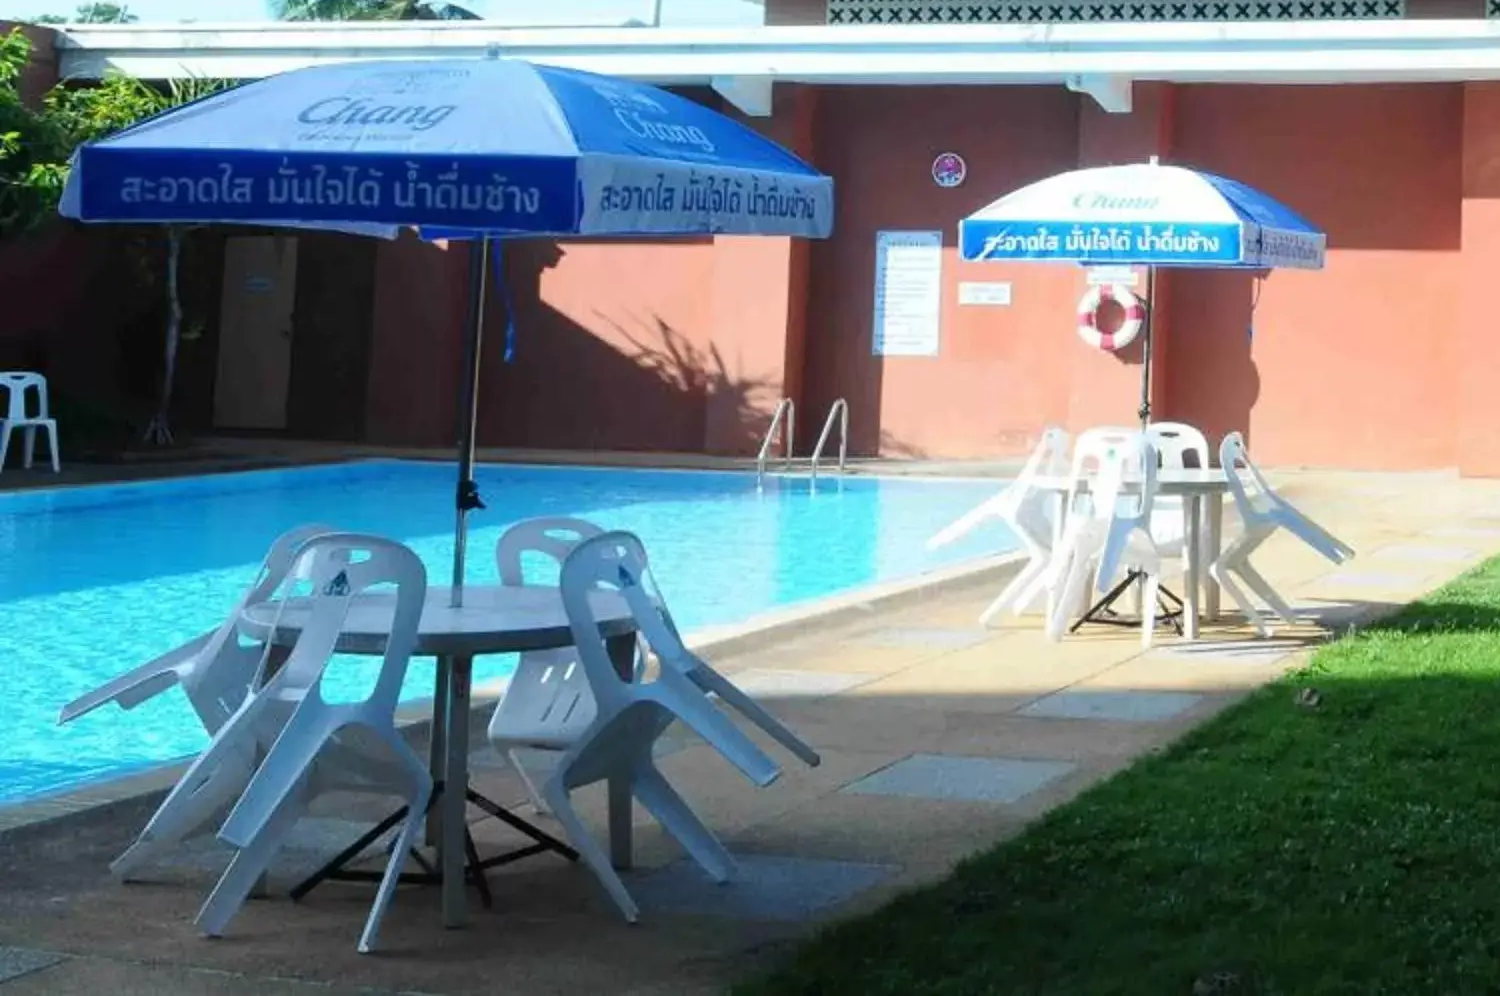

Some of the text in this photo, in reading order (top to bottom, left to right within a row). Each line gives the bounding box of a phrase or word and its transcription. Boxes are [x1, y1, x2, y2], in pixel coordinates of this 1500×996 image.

[298, 96, 458, 131] Chang
[614, 107, 716, 153] Chang
[120, 156, 541, 214] สะอาดใส มั่นใจได้ น้ำดื่มช้าง
[601, 172, 676, 212] สะอาดใส
